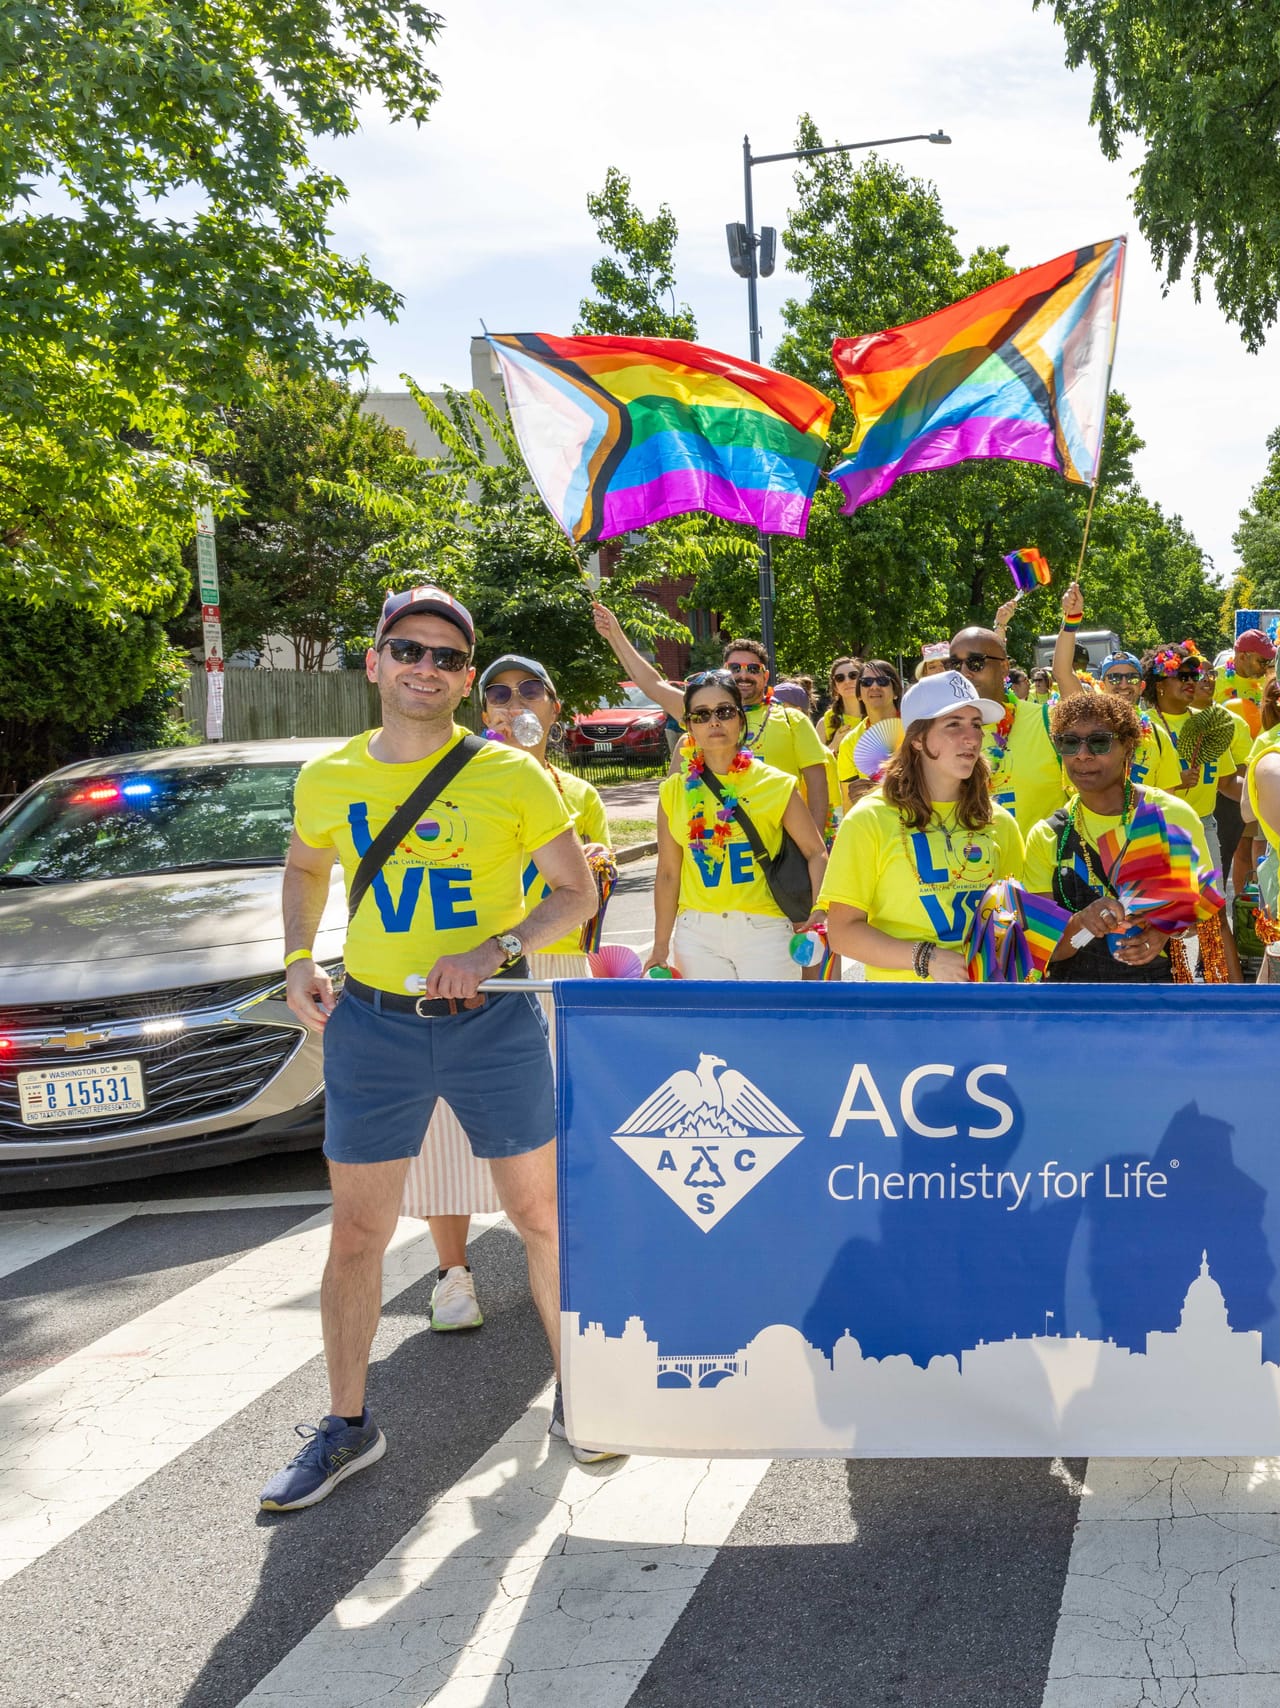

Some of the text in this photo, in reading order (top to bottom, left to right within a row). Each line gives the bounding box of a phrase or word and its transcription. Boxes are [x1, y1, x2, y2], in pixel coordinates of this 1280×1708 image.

[371, 866, 478, 933] VE
[65, 1076, 132, 1108] 15531
[829, 1063, 1015, 1139] ACS
[27, 1112, 39, 1121] END
[67, 1107, 92, 1116] WITHOUT
[657, 1149, 756, 1172] A C
[828, 1161, 1031, 1211] Chemistry
[1038, 1161, 1094, 1199] for
[696, 1193, 715, 1215] S
